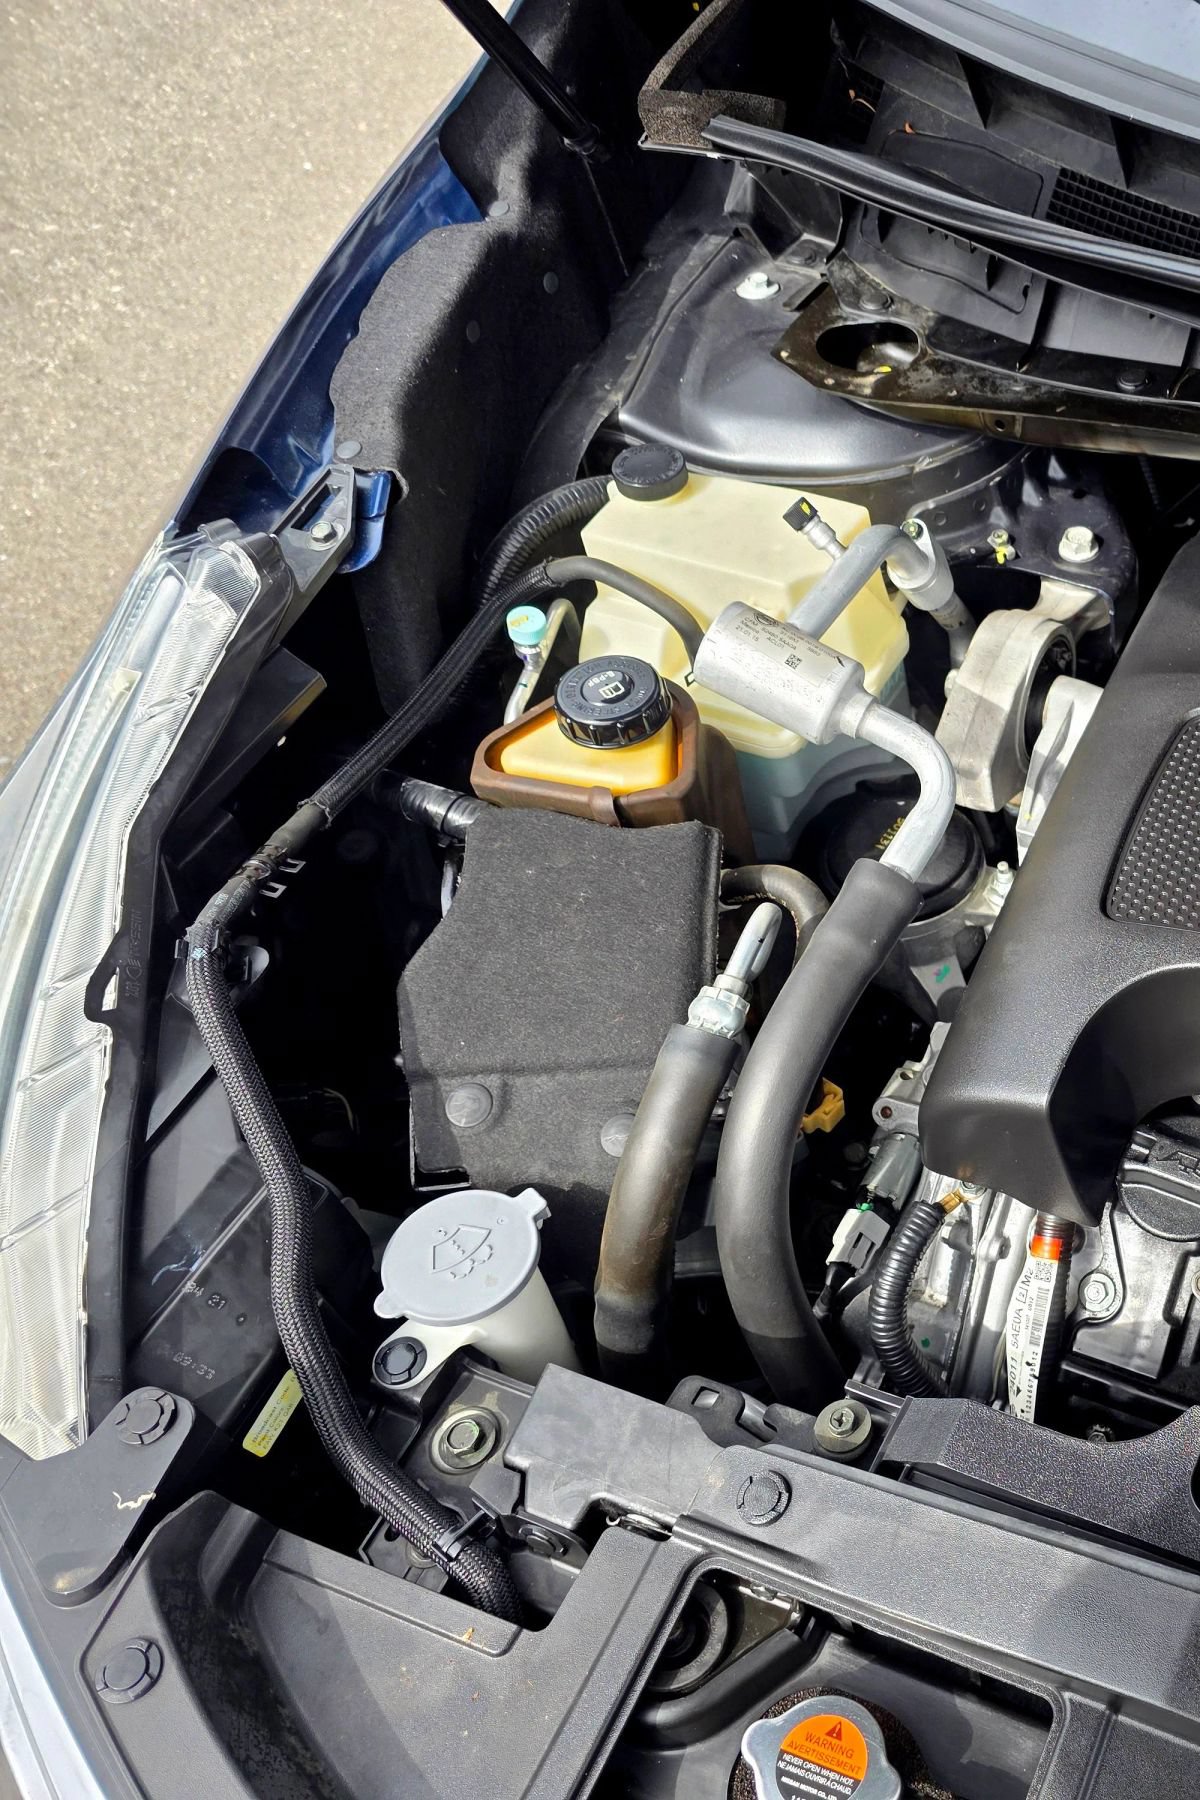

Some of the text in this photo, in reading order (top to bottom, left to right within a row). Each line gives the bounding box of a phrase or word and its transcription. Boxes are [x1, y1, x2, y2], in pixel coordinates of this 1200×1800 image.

[787, 1739, 862, 1775] AVERTISSEMENT
[805, 1731, 855, 1759] WARNING
[777, 1760, 787, 1769] NE
[784, 1763, 806, 1777] JAMAIS
[805, 1771, 826, 1786] OUVRIR
[782, 1752, 803, 1766] NEVER
[803, 1760, 821, 1773] OPEN
[820, 1766, 840, 1781] WHEN
